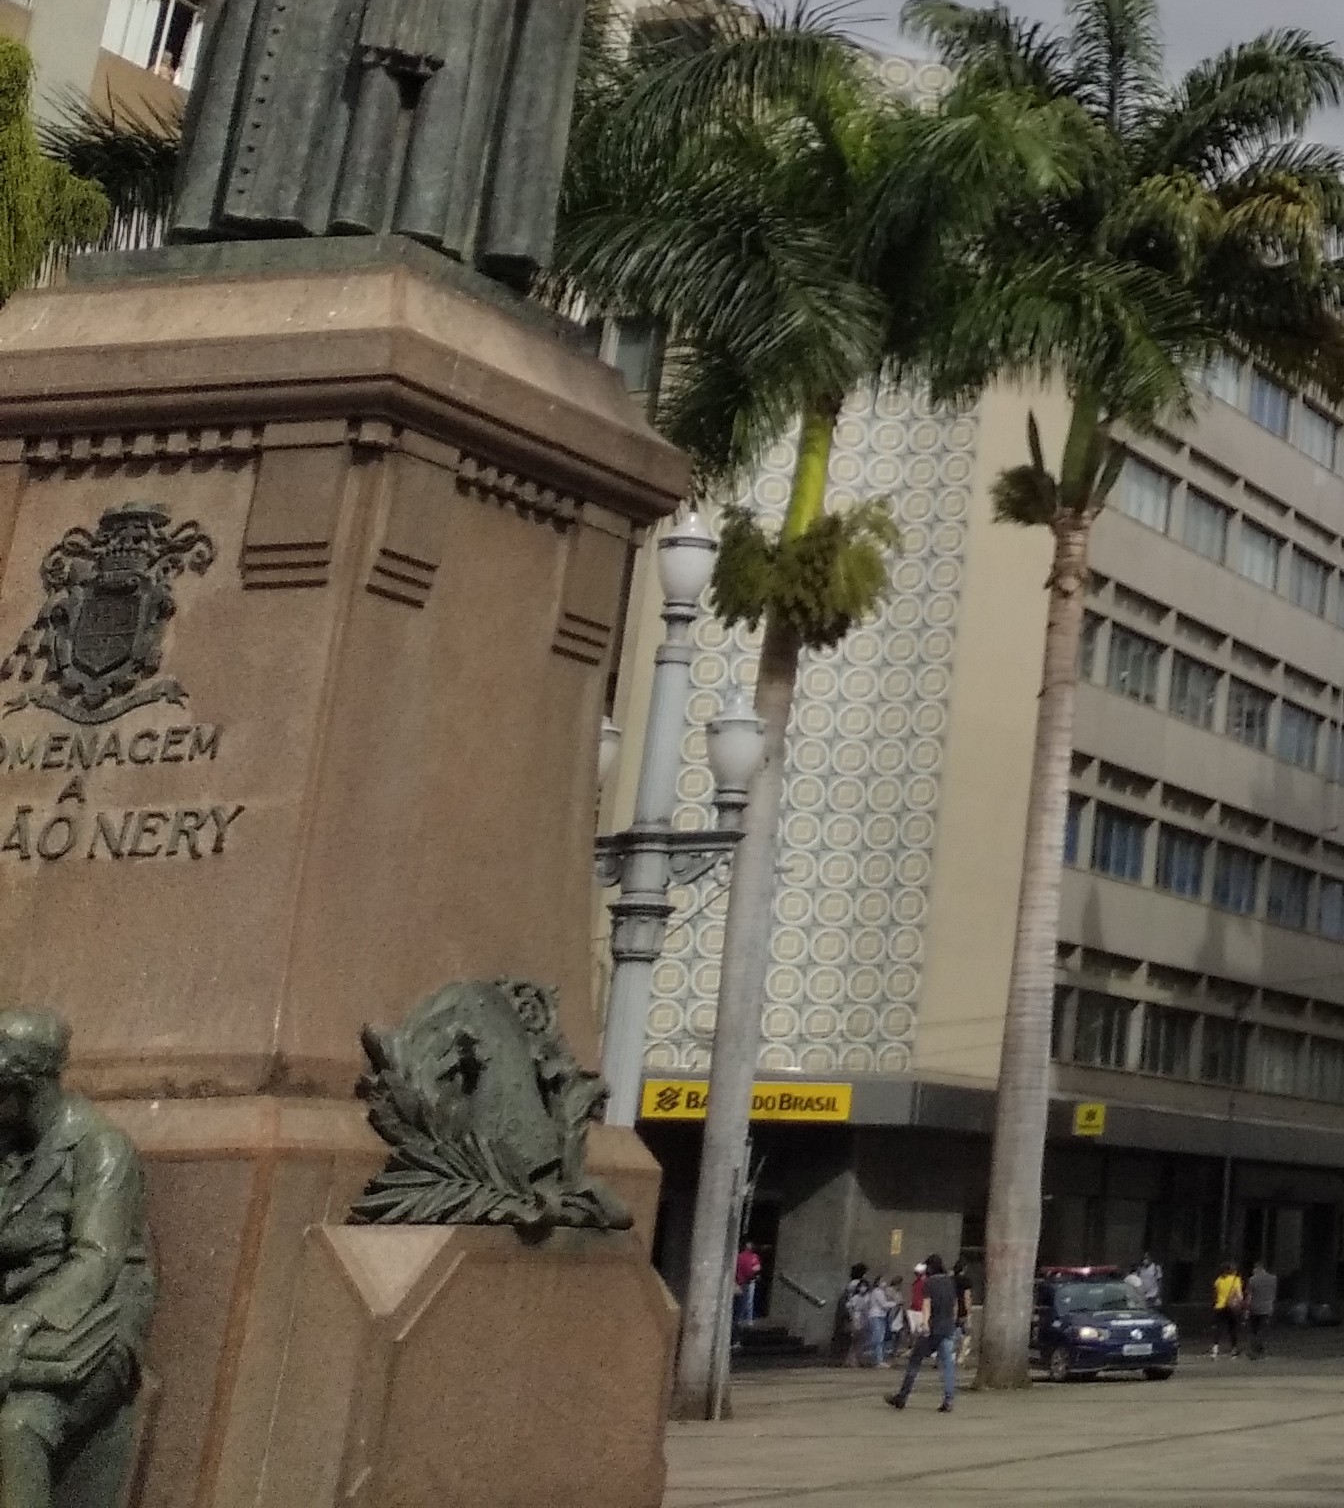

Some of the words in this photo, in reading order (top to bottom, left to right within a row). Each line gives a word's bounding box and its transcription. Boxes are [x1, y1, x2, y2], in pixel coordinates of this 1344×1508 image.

[0, 725, 225, 771] MENAGEM
[86, 804, 246, 861] NERY
[752, 1094, 776, 1111] DO
[778, 1092, 839, 1112] BRASIL
